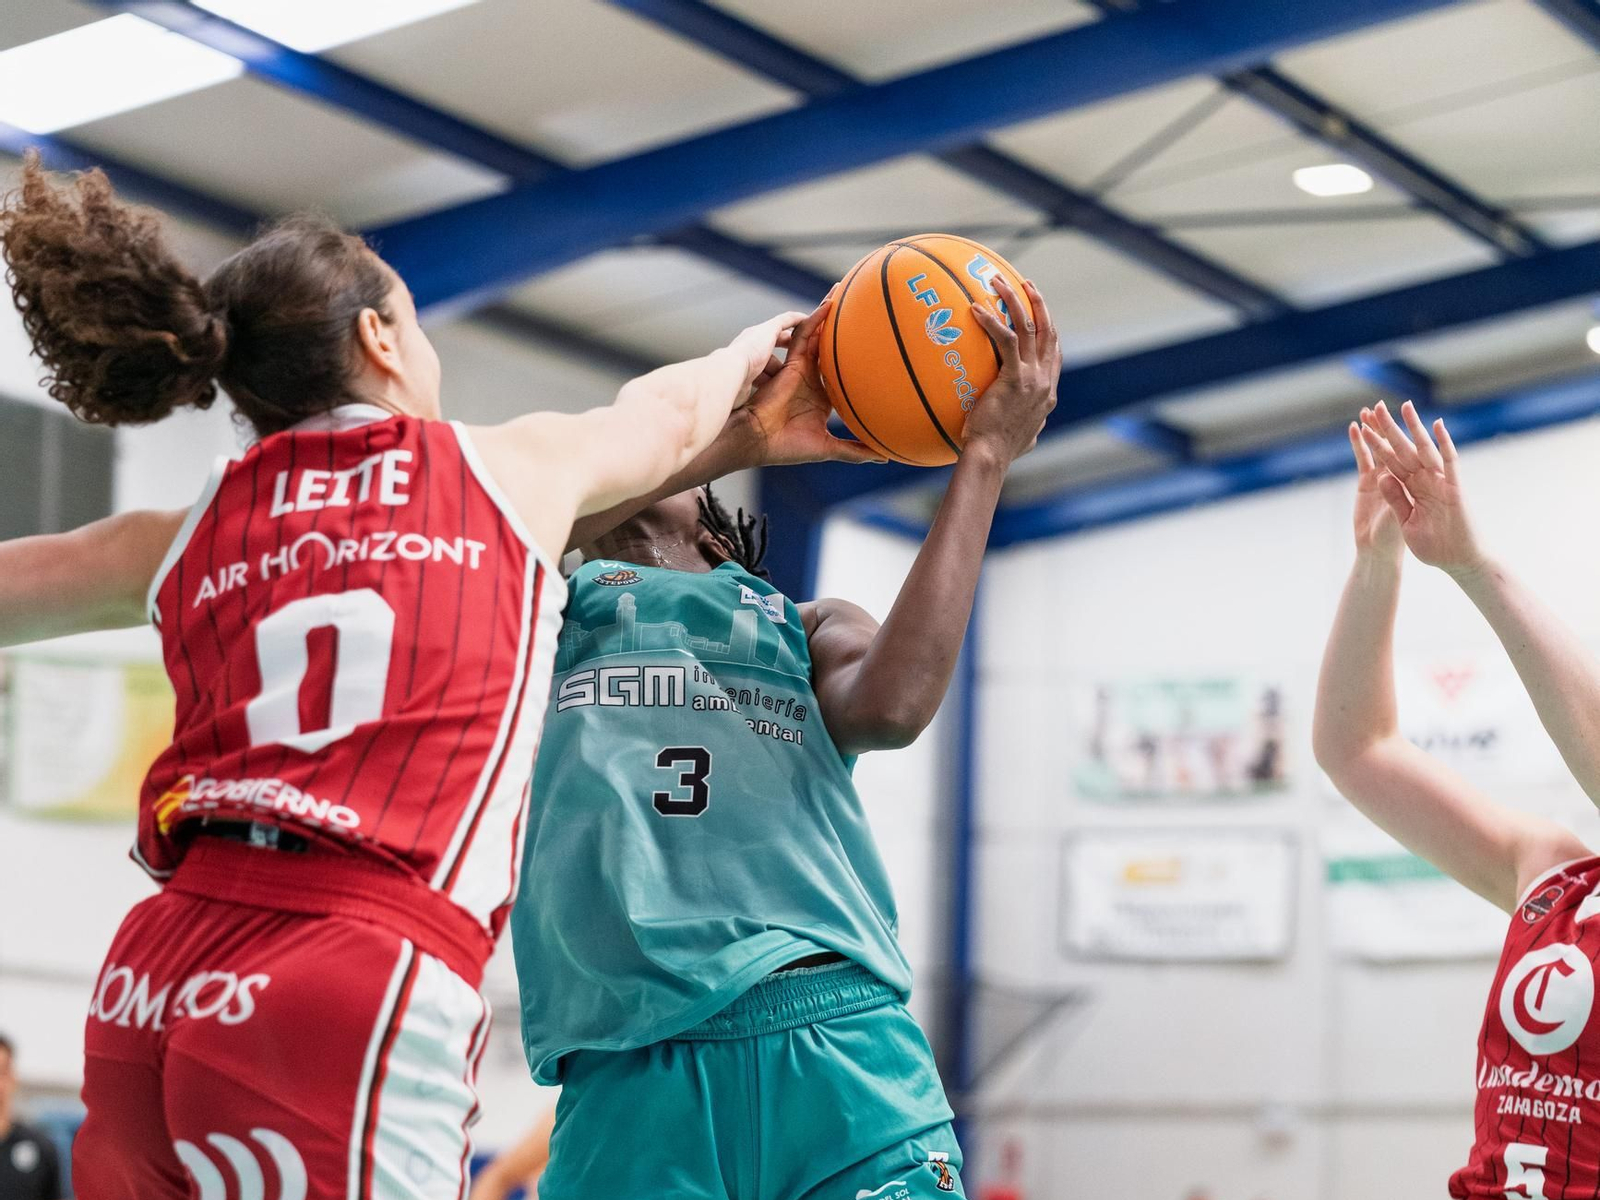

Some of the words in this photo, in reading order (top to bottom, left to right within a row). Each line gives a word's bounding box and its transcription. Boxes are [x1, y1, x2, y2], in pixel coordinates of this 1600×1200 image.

[906, 273, 941, 308] LF
[944, 350, 979, 420] ende
[269, 449, 413, 519] LEITE
[193, 561, 249, 608] AIR
[260, 531, 486, 581] HORIZONT
[245, 588, 396, 754] 0
[556, 665, 686, 713] SGM
[694, 665, 807, 721] ineniería
[692, 695, 803, 745] amental
[652, 745, 713, 818] 3
[895, 1188, 910, 1199] SOL
